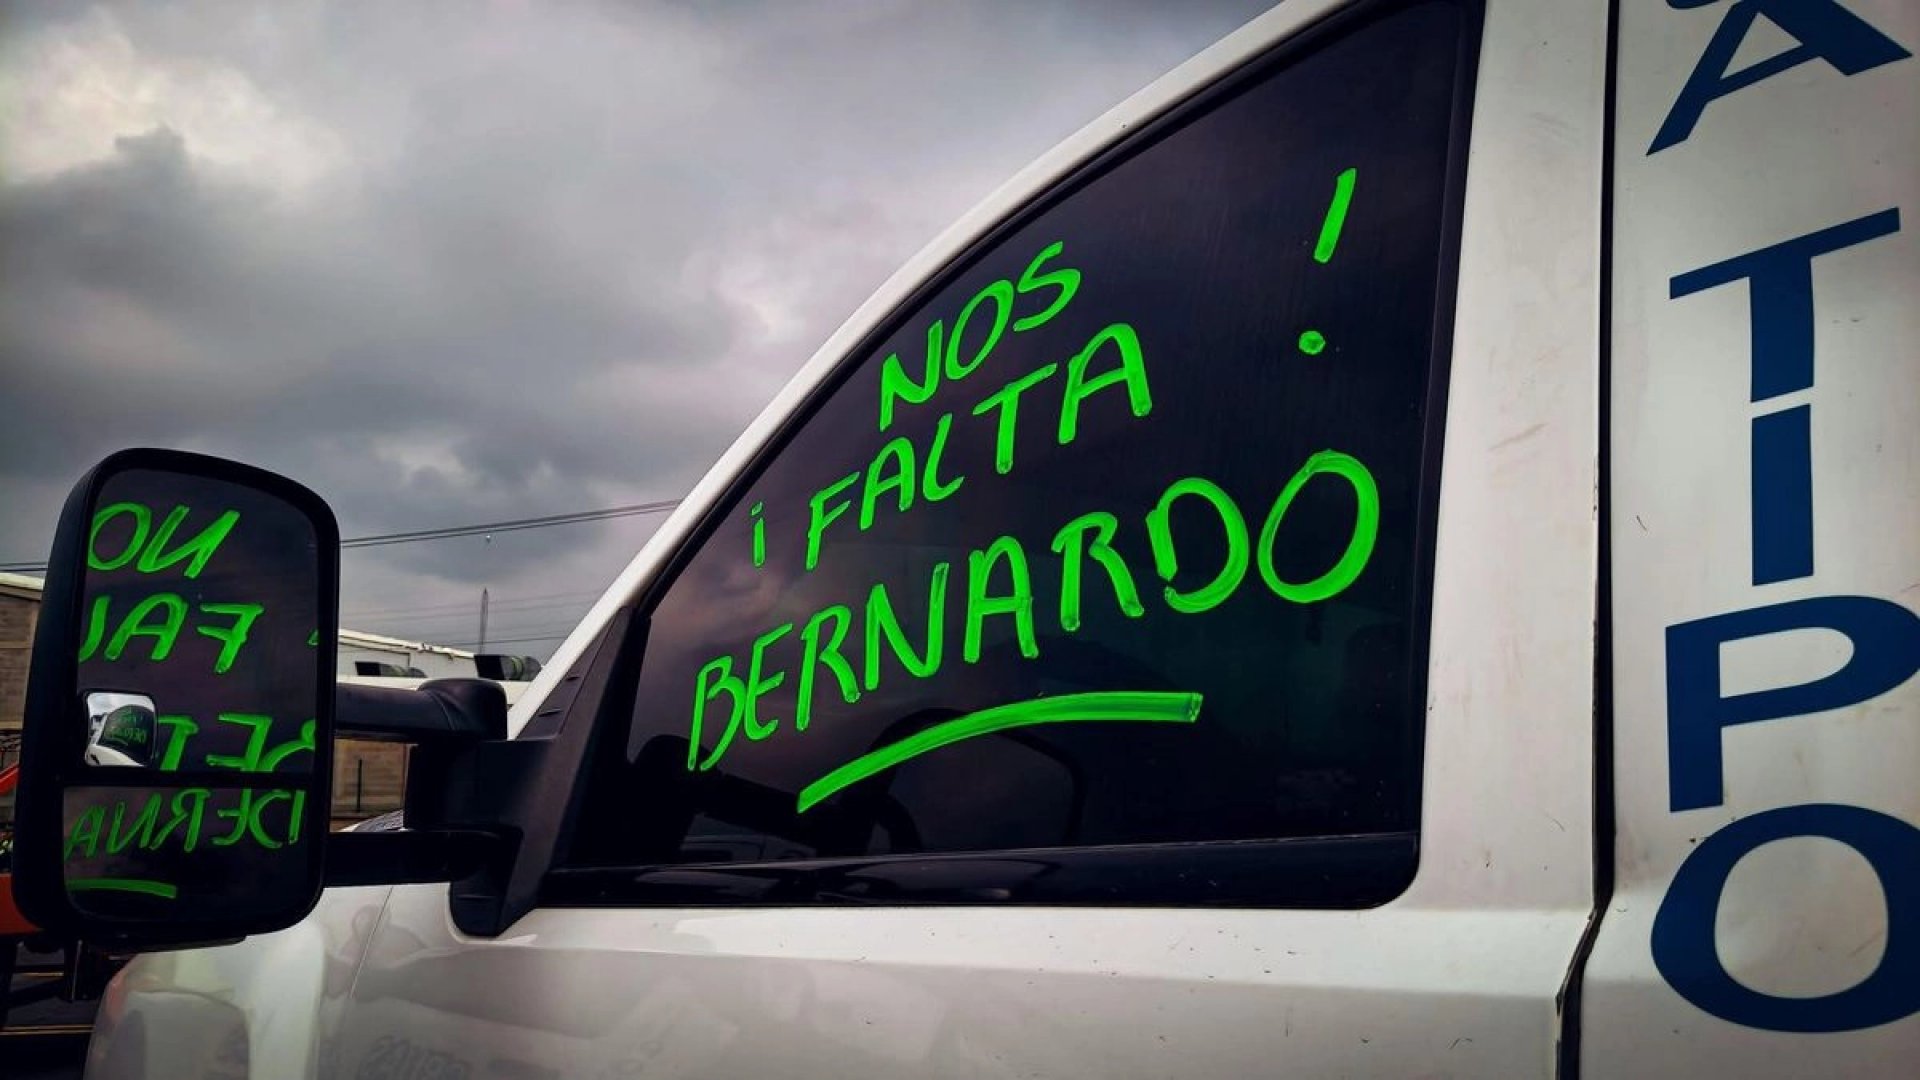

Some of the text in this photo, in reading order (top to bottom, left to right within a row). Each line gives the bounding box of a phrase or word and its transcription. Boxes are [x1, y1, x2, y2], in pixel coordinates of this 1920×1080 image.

[806, 324, 1153, 571] FALTA
[880, 241, 1081, 431] NOS
[687, 449, 1379, 770] BERNARDO
[1646, 0, 1920, 1032] A TIPO
